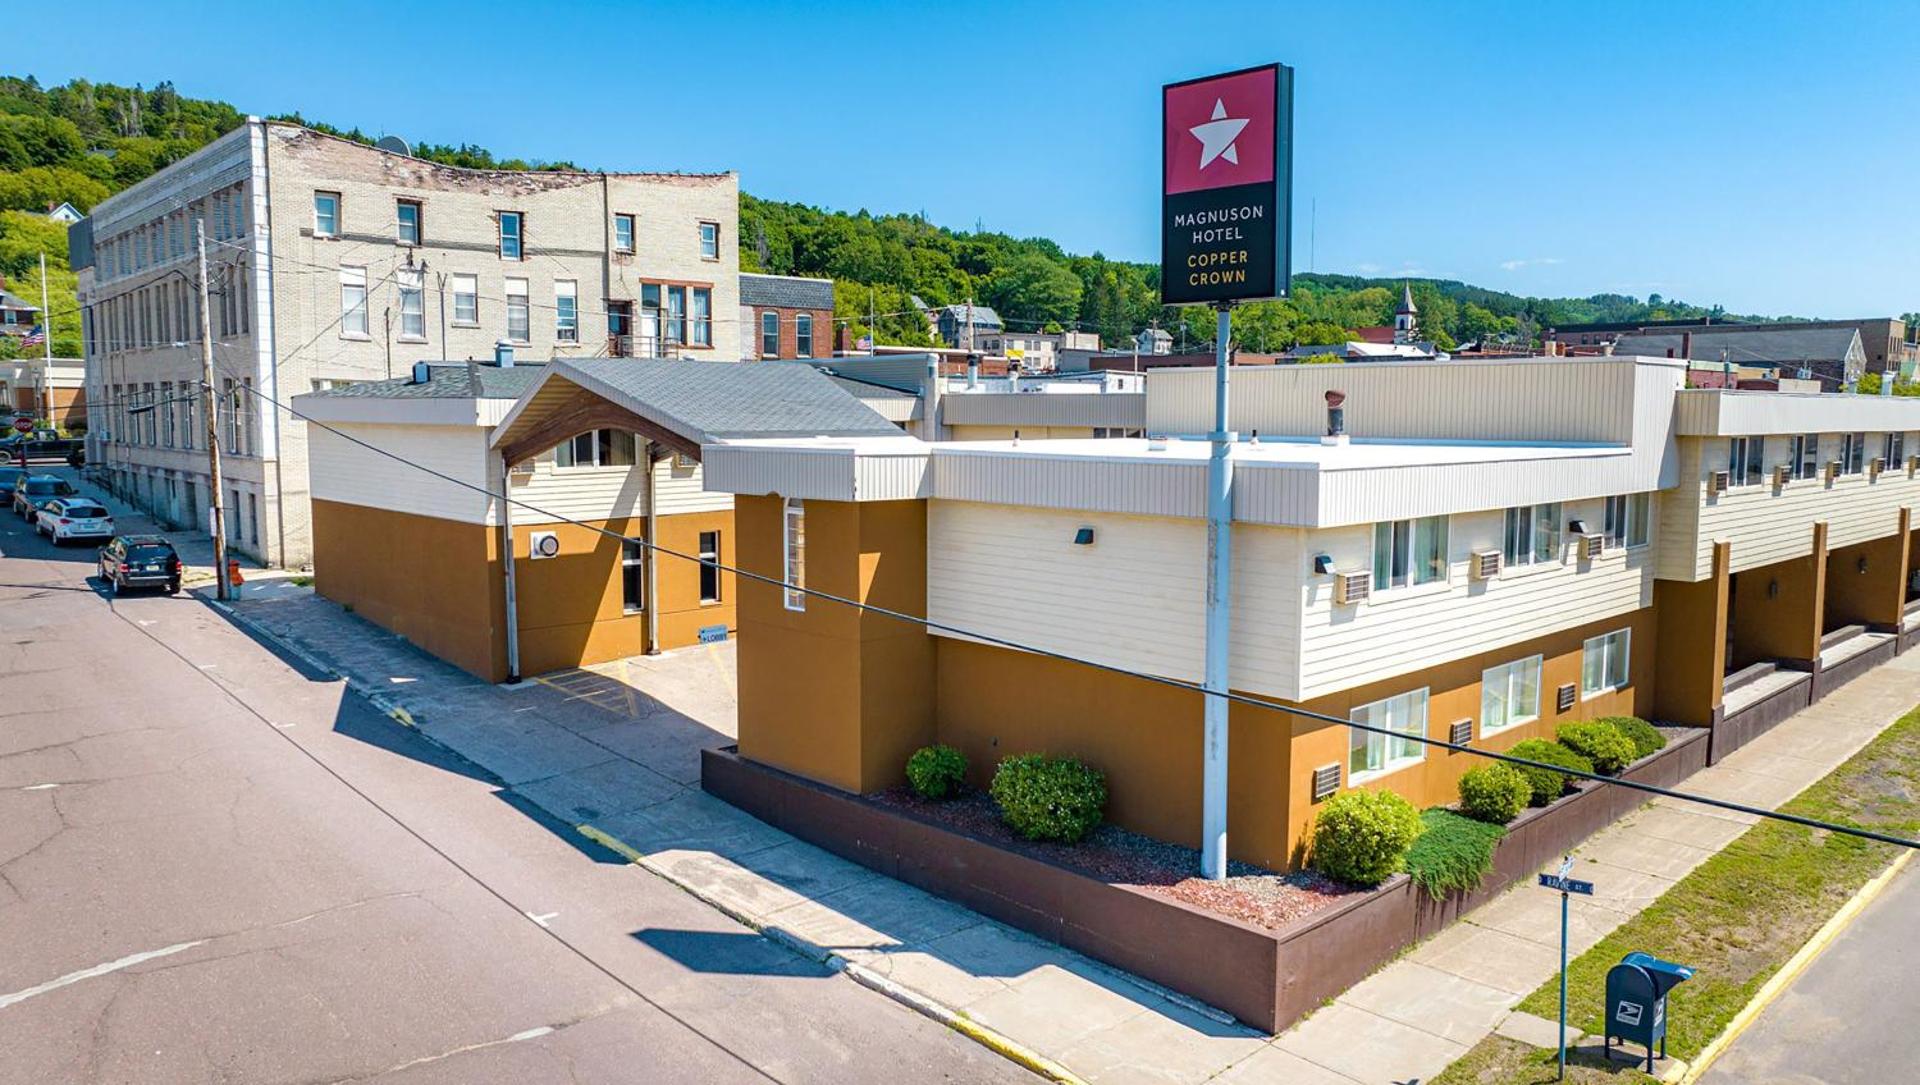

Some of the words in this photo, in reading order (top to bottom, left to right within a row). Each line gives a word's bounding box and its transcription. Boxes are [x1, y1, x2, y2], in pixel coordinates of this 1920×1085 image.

[1174, 205, 1263, 228] MAGNUSON
[1192, 227, 1243, 244] HOTEL
[1187, 250, 1248, 268] COPPER
[1189, 269, 1245, 286] CROWN
